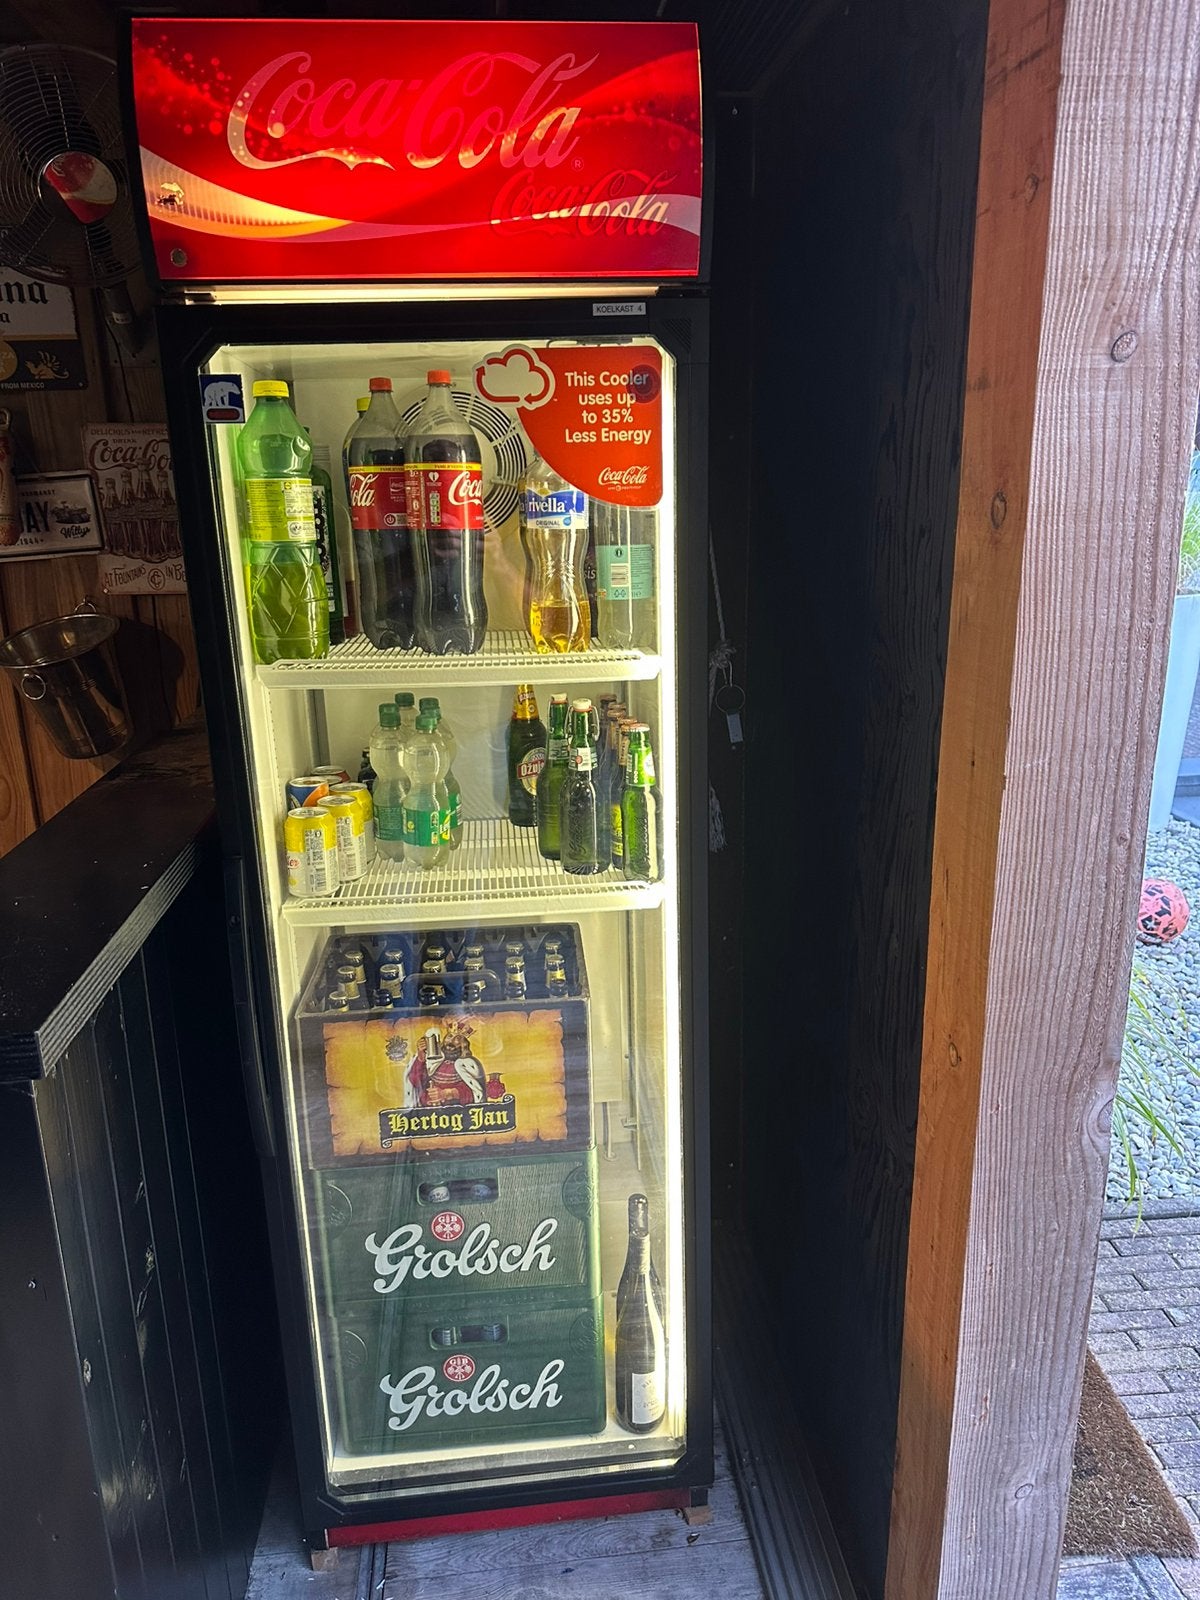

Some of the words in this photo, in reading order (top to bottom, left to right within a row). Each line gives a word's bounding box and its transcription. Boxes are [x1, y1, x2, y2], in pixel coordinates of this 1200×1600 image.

[227, 51, 600, 171] Coca-Cola
[0, 281, 48, 305] na
[596, 305, 634, 313] KOELKAST
[565, 371, 595, 387] This
[600, 370, 649, 386] Cooler
[579, 394, 613, 406] uses
[617, 393, 636, 408] up
[582, 410, 597, 424] to
[602, 408, 633, 423] 35%
[565, 428, 597, 443] Less
[601, 427, 652, 444] Energy
[598, 465, 650, 486] Coca-Cola
[528, 497, 567, 513] rivella
[388, 1111, 464, 1135] Hertog
[468, 1106, 509, 1129] Jan
[364, 1218, 559, 1294] Grolsch
[379, 1359, 566, 1431] Grolsch
